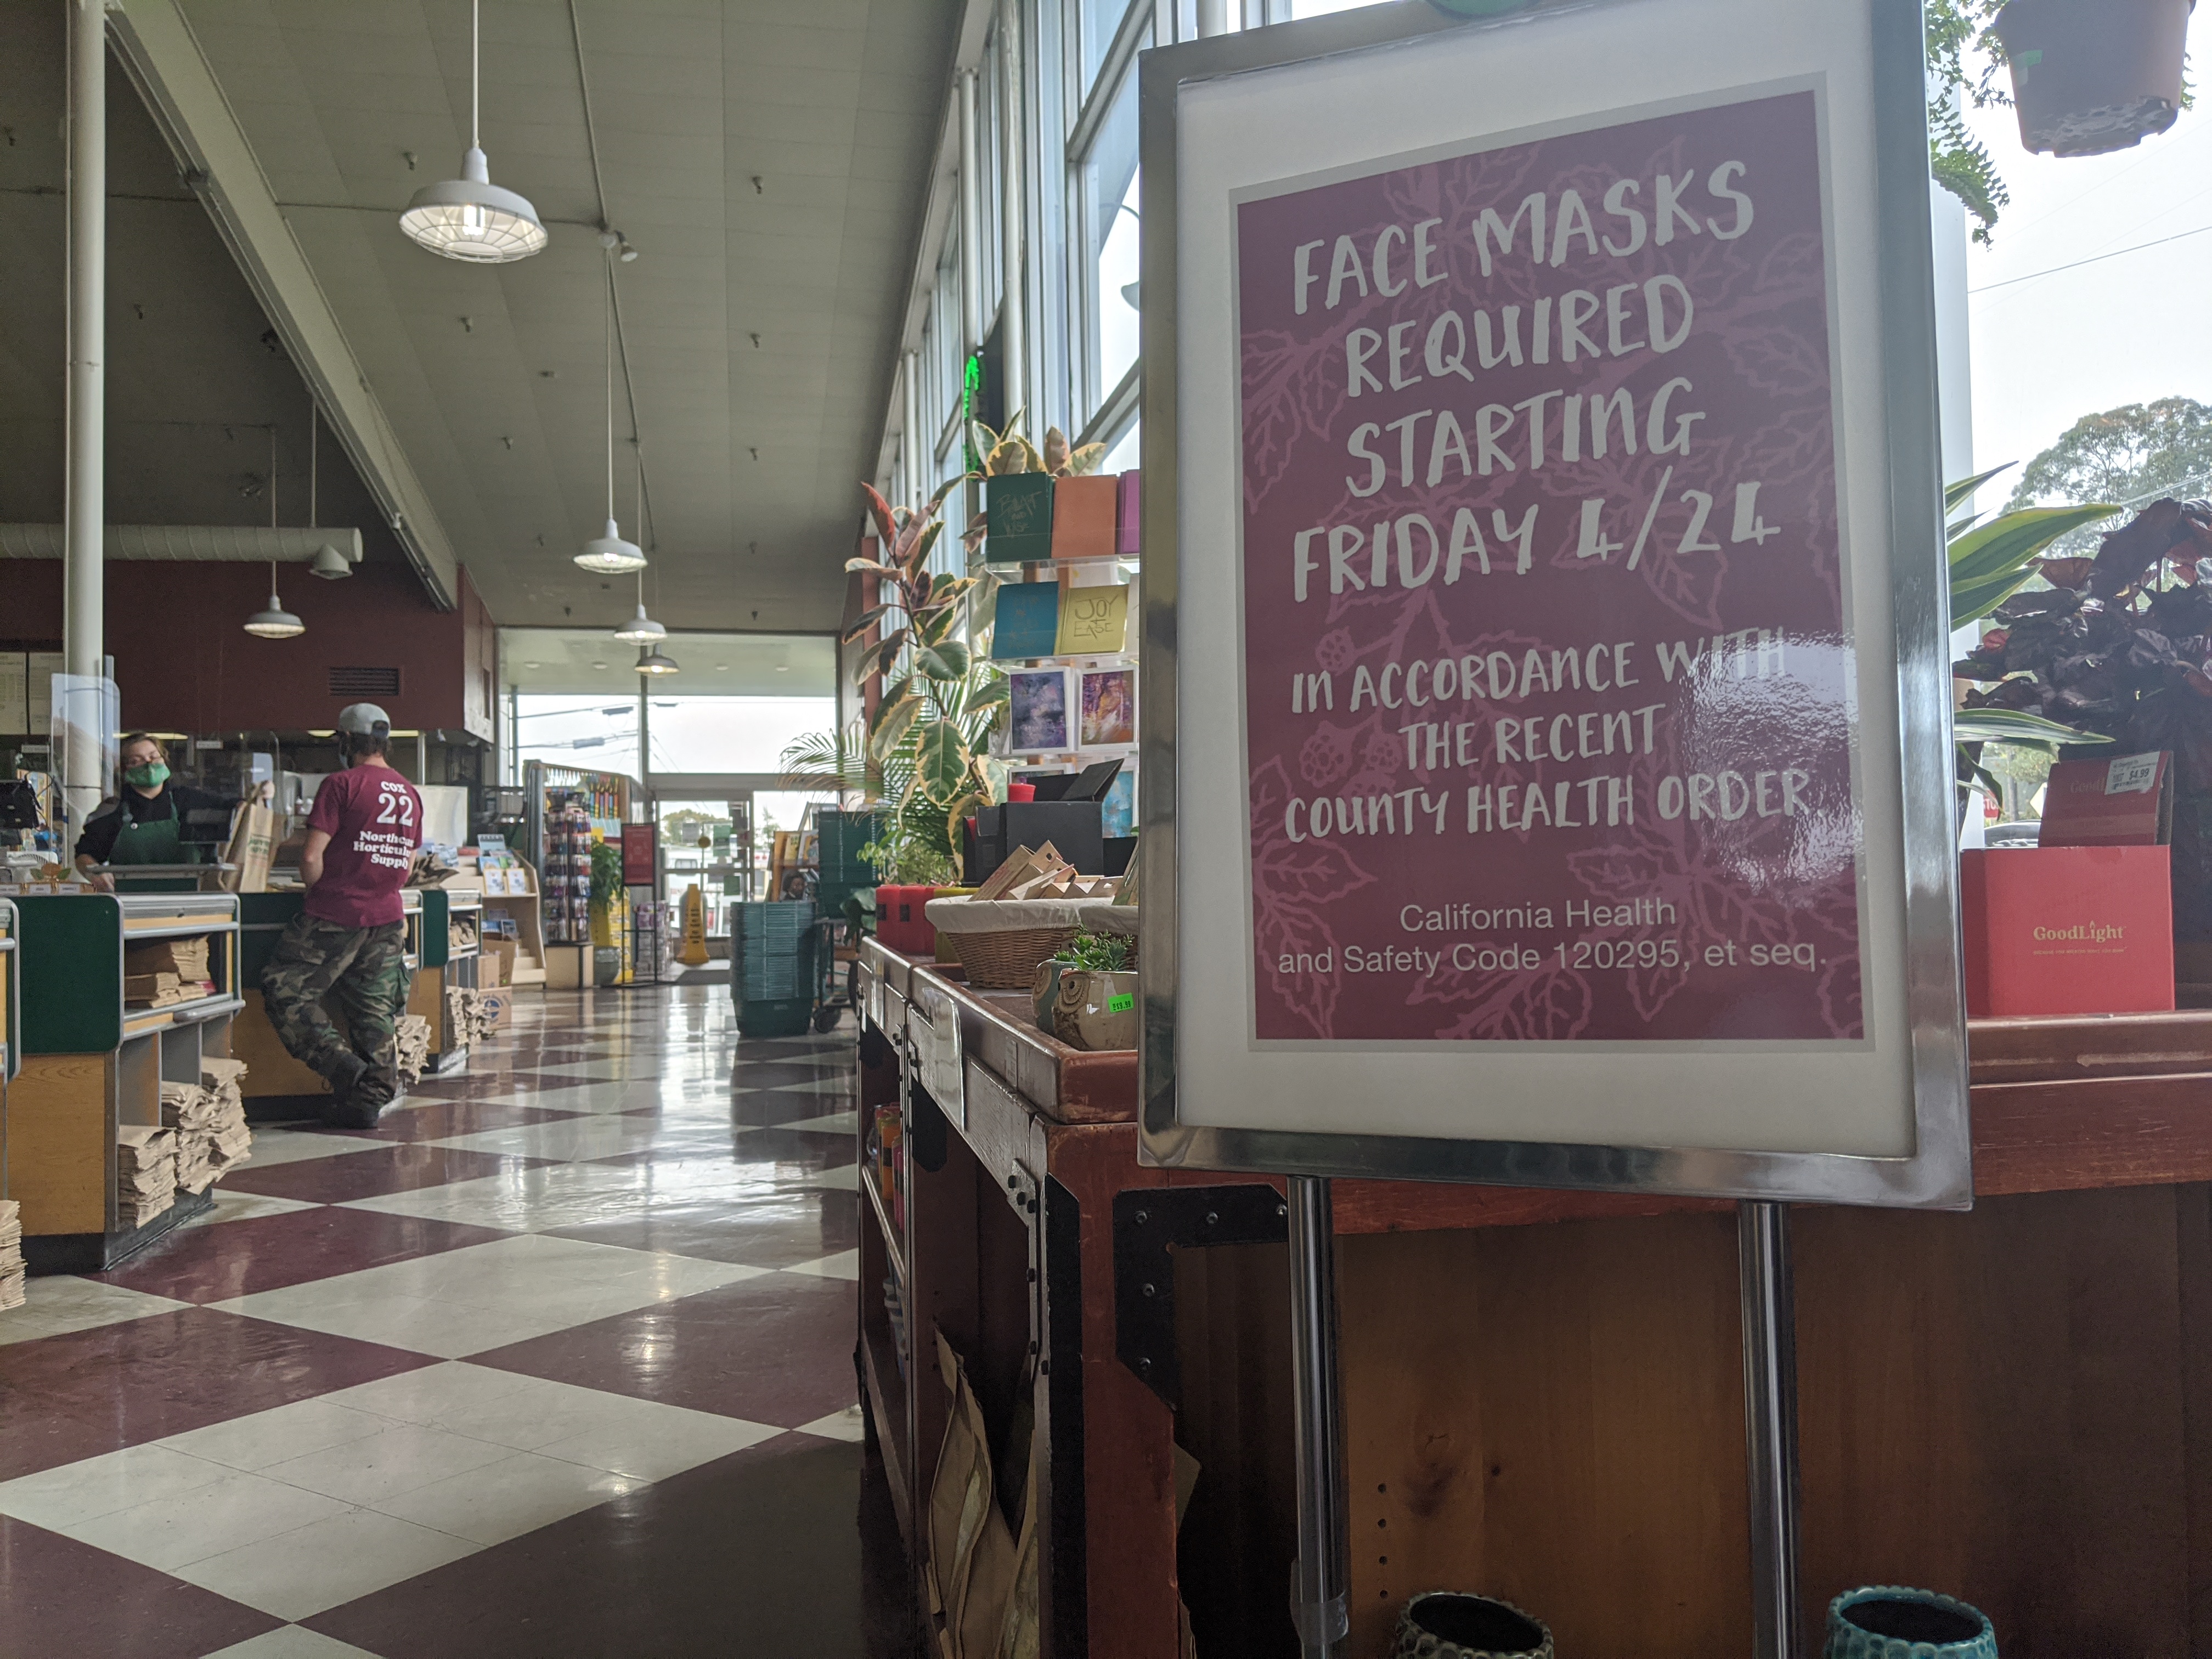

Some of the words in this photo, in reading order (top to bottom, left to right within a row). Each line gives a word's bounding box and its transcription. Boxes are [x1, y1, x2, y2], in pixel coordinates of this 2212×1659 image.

[1295, 217, 1448, 315] FACE
[1472, 160, 1754, 277] MASKS
[1345, 274, 1694, 398] REQUIRED
[1346, 377, 1706, 498] STARTING
[1294, 504, 1539, 603] FRIDAY
[1577, 465, 1781, 571] 4/24
[1074, 620, 1114, 639] EASE
[1075, 594, 1119, 620] JOY
[1292, 670, 1334, 713] IN
[1350, 641, 1640, 712] ACCORDANCE
[1656, 626, 1786, 683] WITH
[1398, 721, 1479, 770] THE
[1495, 703, 1666, 764] RECENT
[376, 793, 413, 827] 22
[1284, 787, 1449, 843] COUNTY
[1467, 775, 1635, 834] HEALTH
[1400, 903, 1554, 932] California
[1566, 898, 1676, 928] Health
[2033, 921, 2123, 943] GoodLight
[1278, 946, 1333, 974] and
[1344, 945, 1441, 979] Safety
[1452, 943, 1541, 972] Code
[1554, 939, 1690, 973] 120295,
[1704, 940, 1737, 967] et
[1750, 943, 1826, 972] seq.
